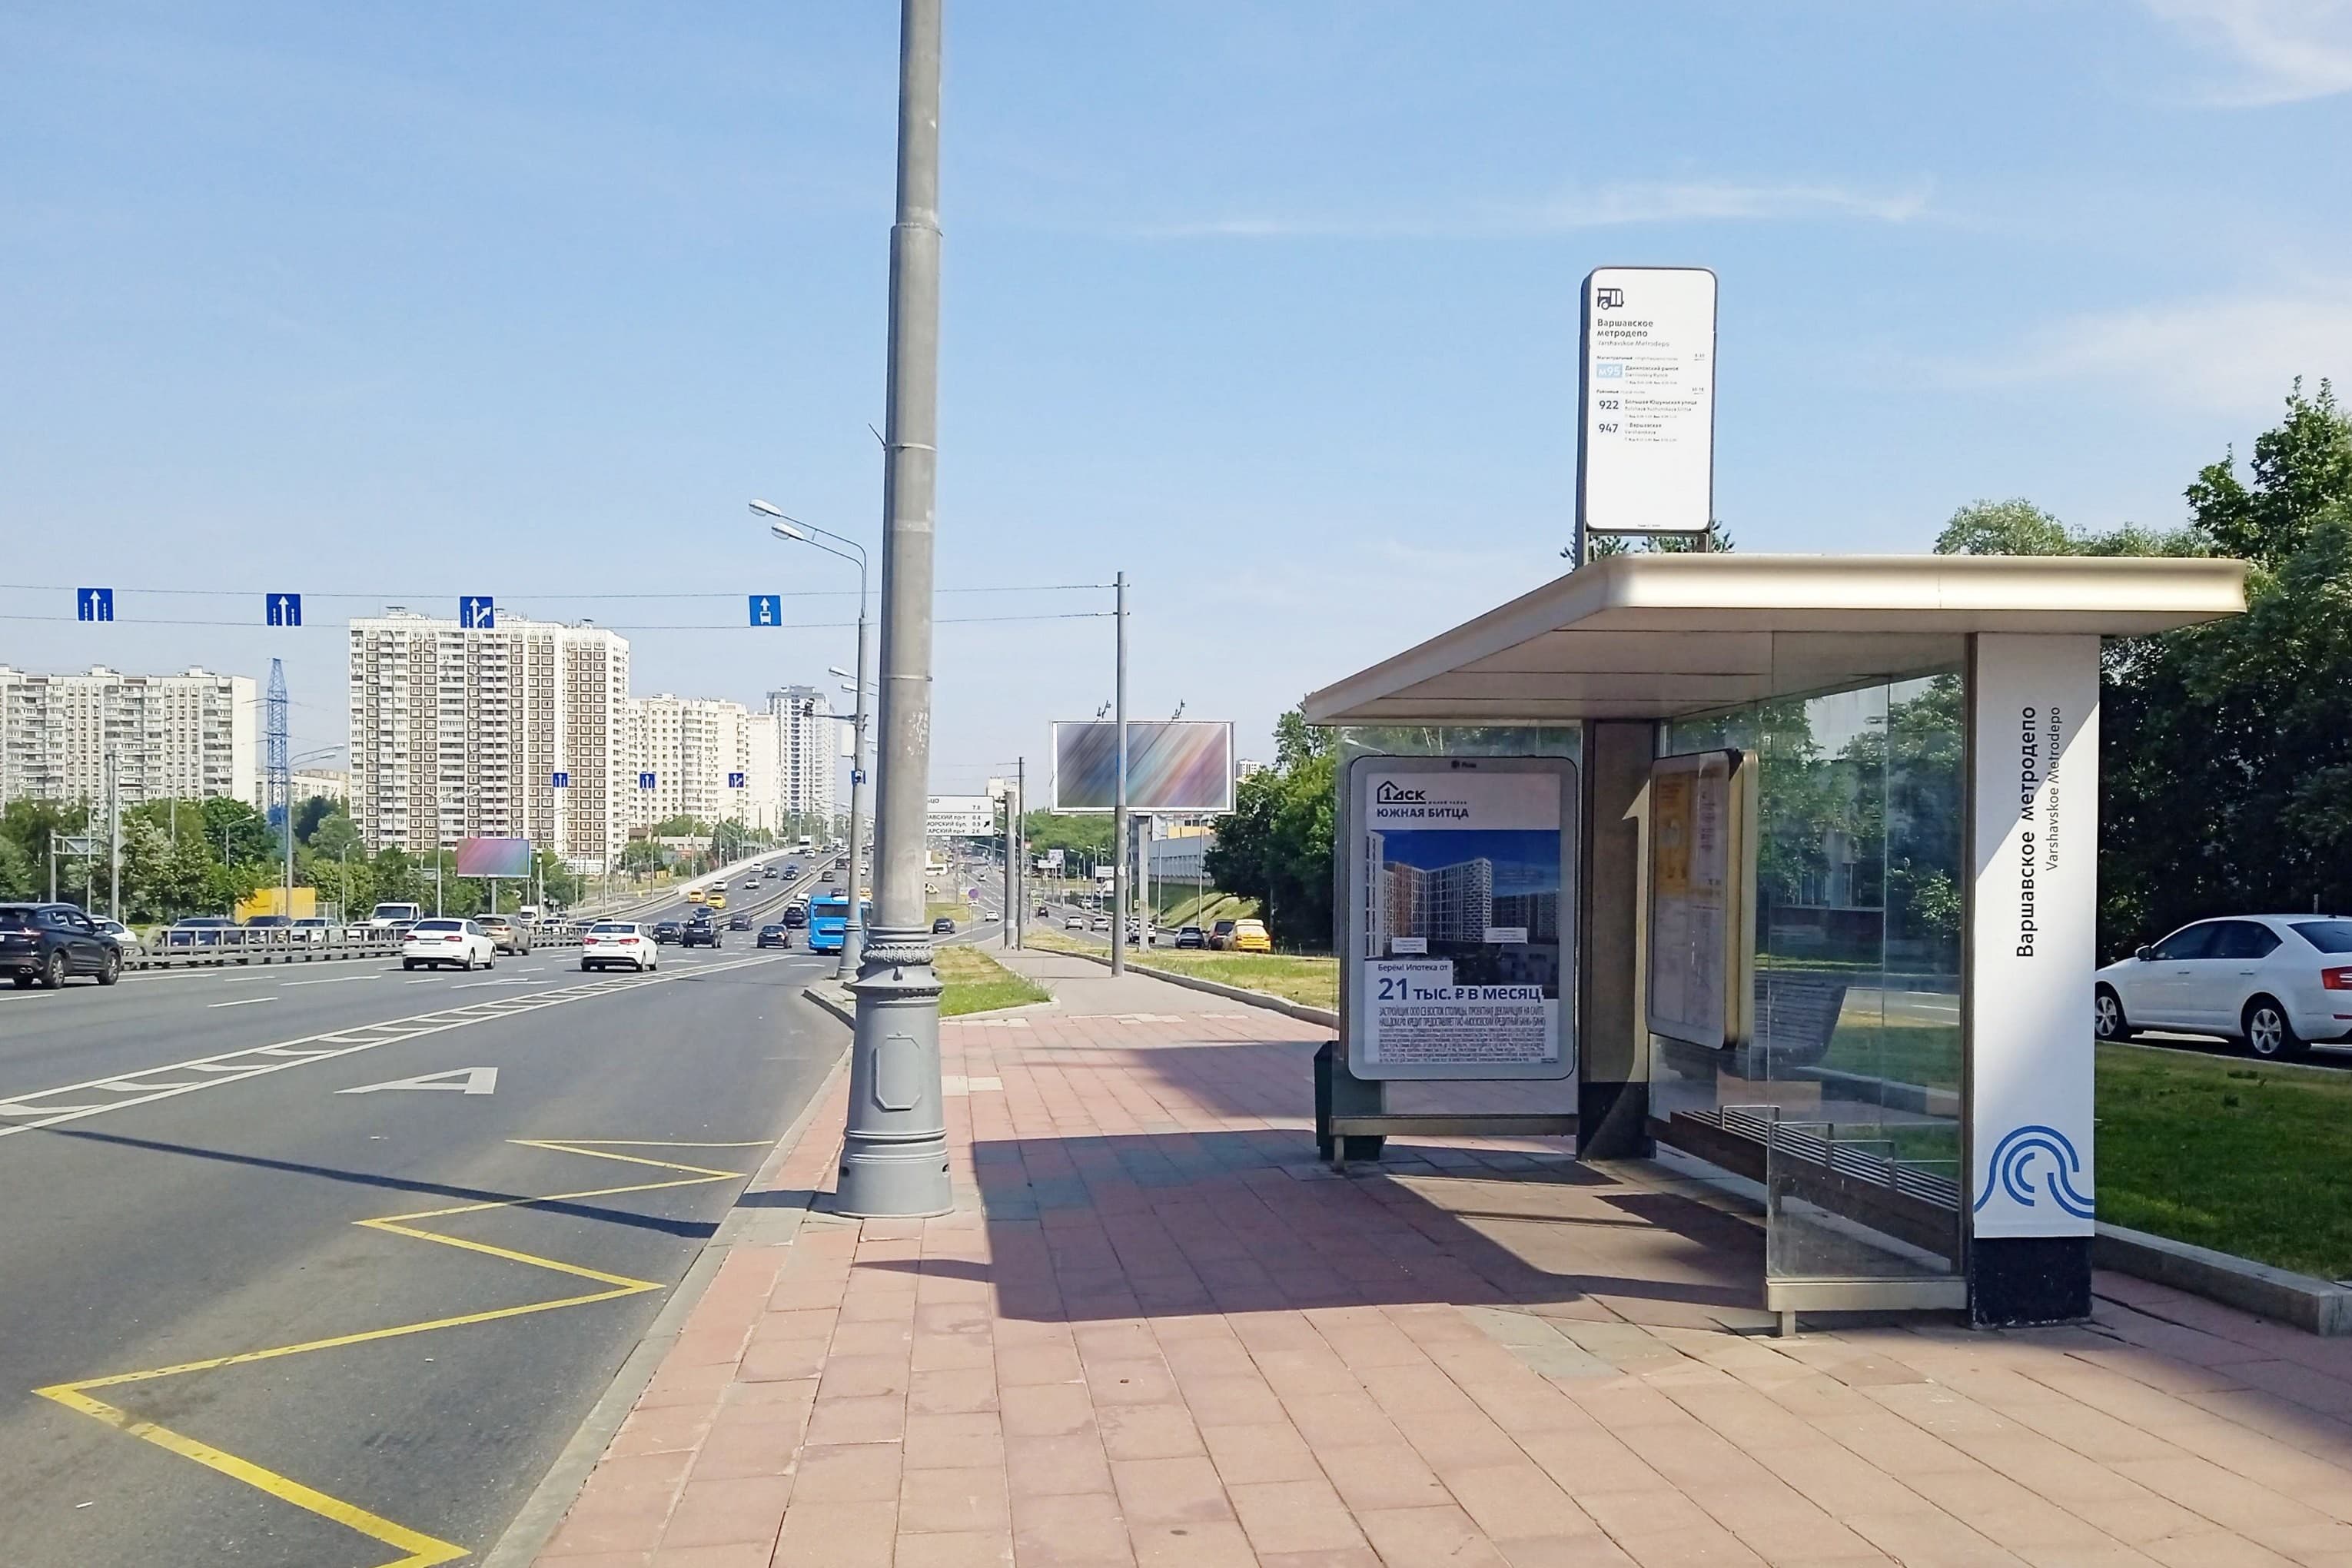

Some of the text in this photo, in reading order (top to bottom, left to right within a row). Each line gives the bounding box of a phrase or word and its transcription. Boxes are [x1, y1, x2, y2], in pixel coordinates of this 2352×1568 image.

[1597, 318, 1654, 328] Варшавское
[1599, 400, 1619, 410] 922
[1599, 424, 1619, 434] 947
[2045, 706, 2063, 872] Varshavskoe Metrodepo
[1377, 808, 1469, 820] ЮЖНАЯ БИТЦА
[2016, 706, 2039, 958] Варшавское метродепо
[1377, 978, 1408, 1000] 21
[1414, 988, 1452, 1000] тыс.
[1467, 988, 1479, 999] в
